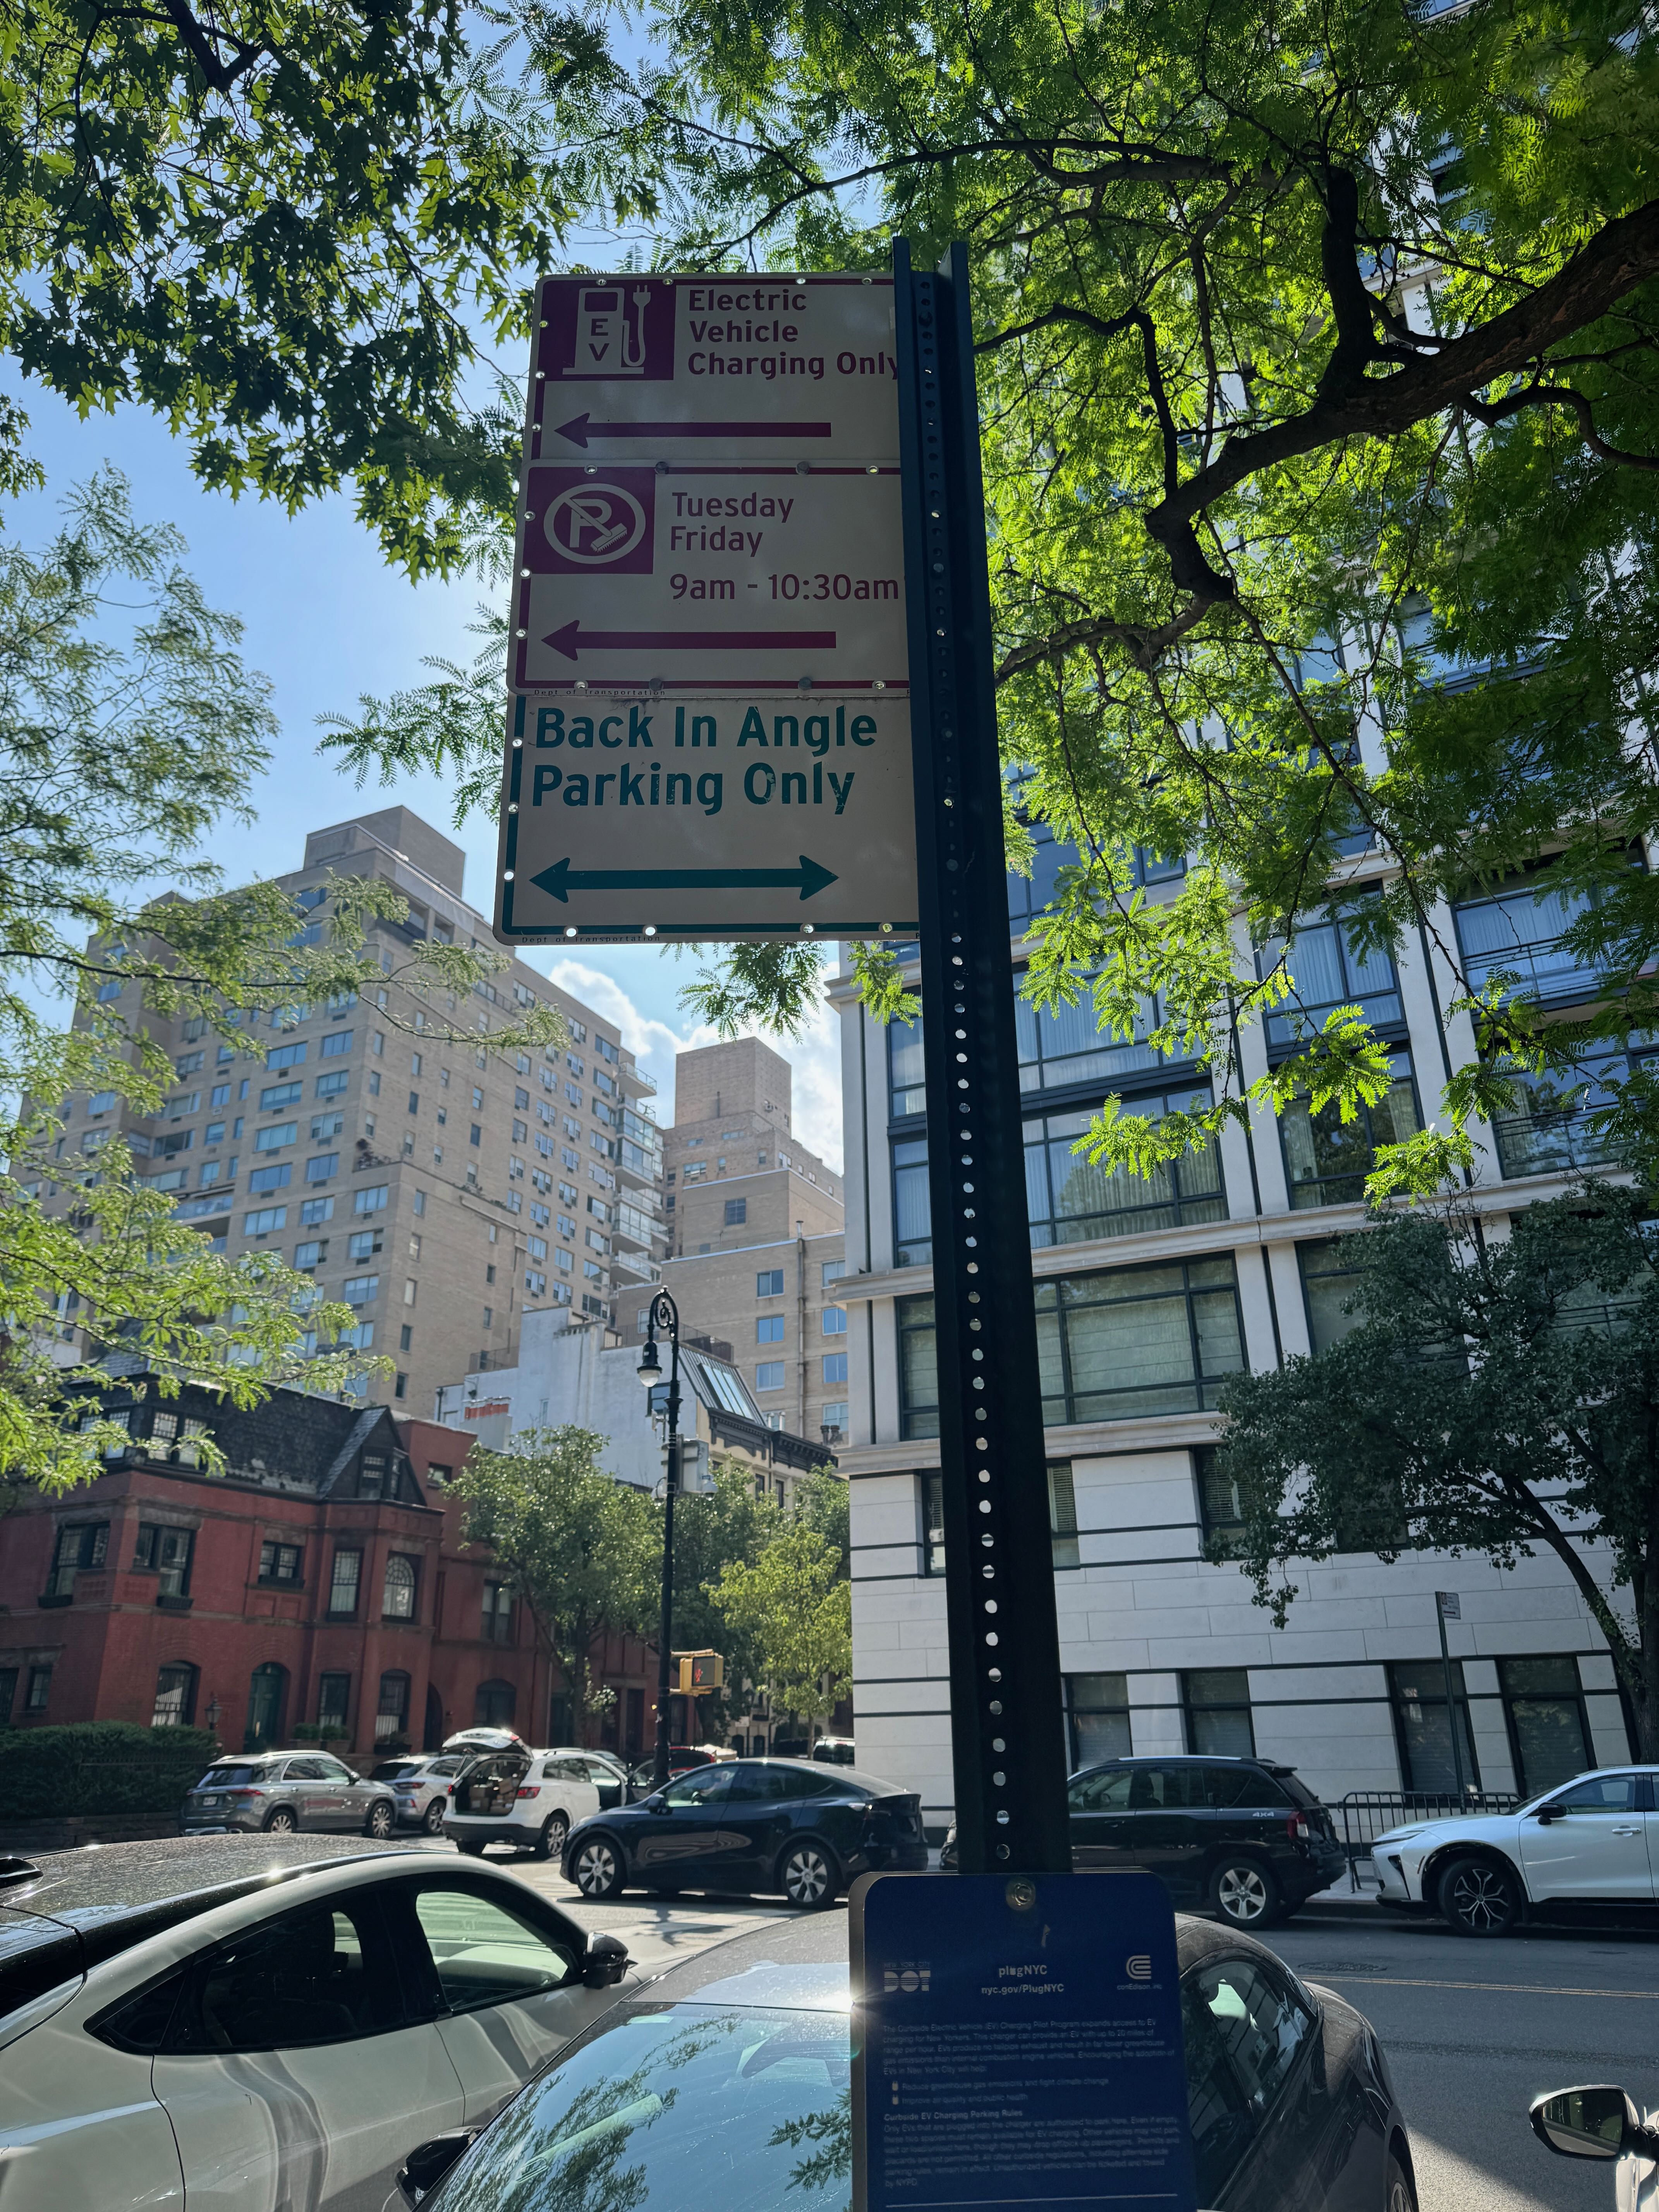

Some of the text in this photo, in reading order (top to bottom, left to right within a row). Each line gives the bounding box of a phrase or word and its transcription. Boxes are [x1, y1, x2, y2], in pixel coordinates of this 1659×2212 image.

[690, 289, 806, 311] Electric
[689, 320, 798, 342] Vehicle
[689, 352, 897, 380] Charging Only
[672, 492, 793, 523] Tuesday
[671, 526, 763, 557] Friday
[670, 574, 734, 599] 9am
[769, 574, 898, 600] 10:30am
[537, 705, 877, 757] Back In Angle
[533, 761, 855, 816] Parking Only
[981, 1984, 1064, 1995] nyc.gov/PlugNYC
